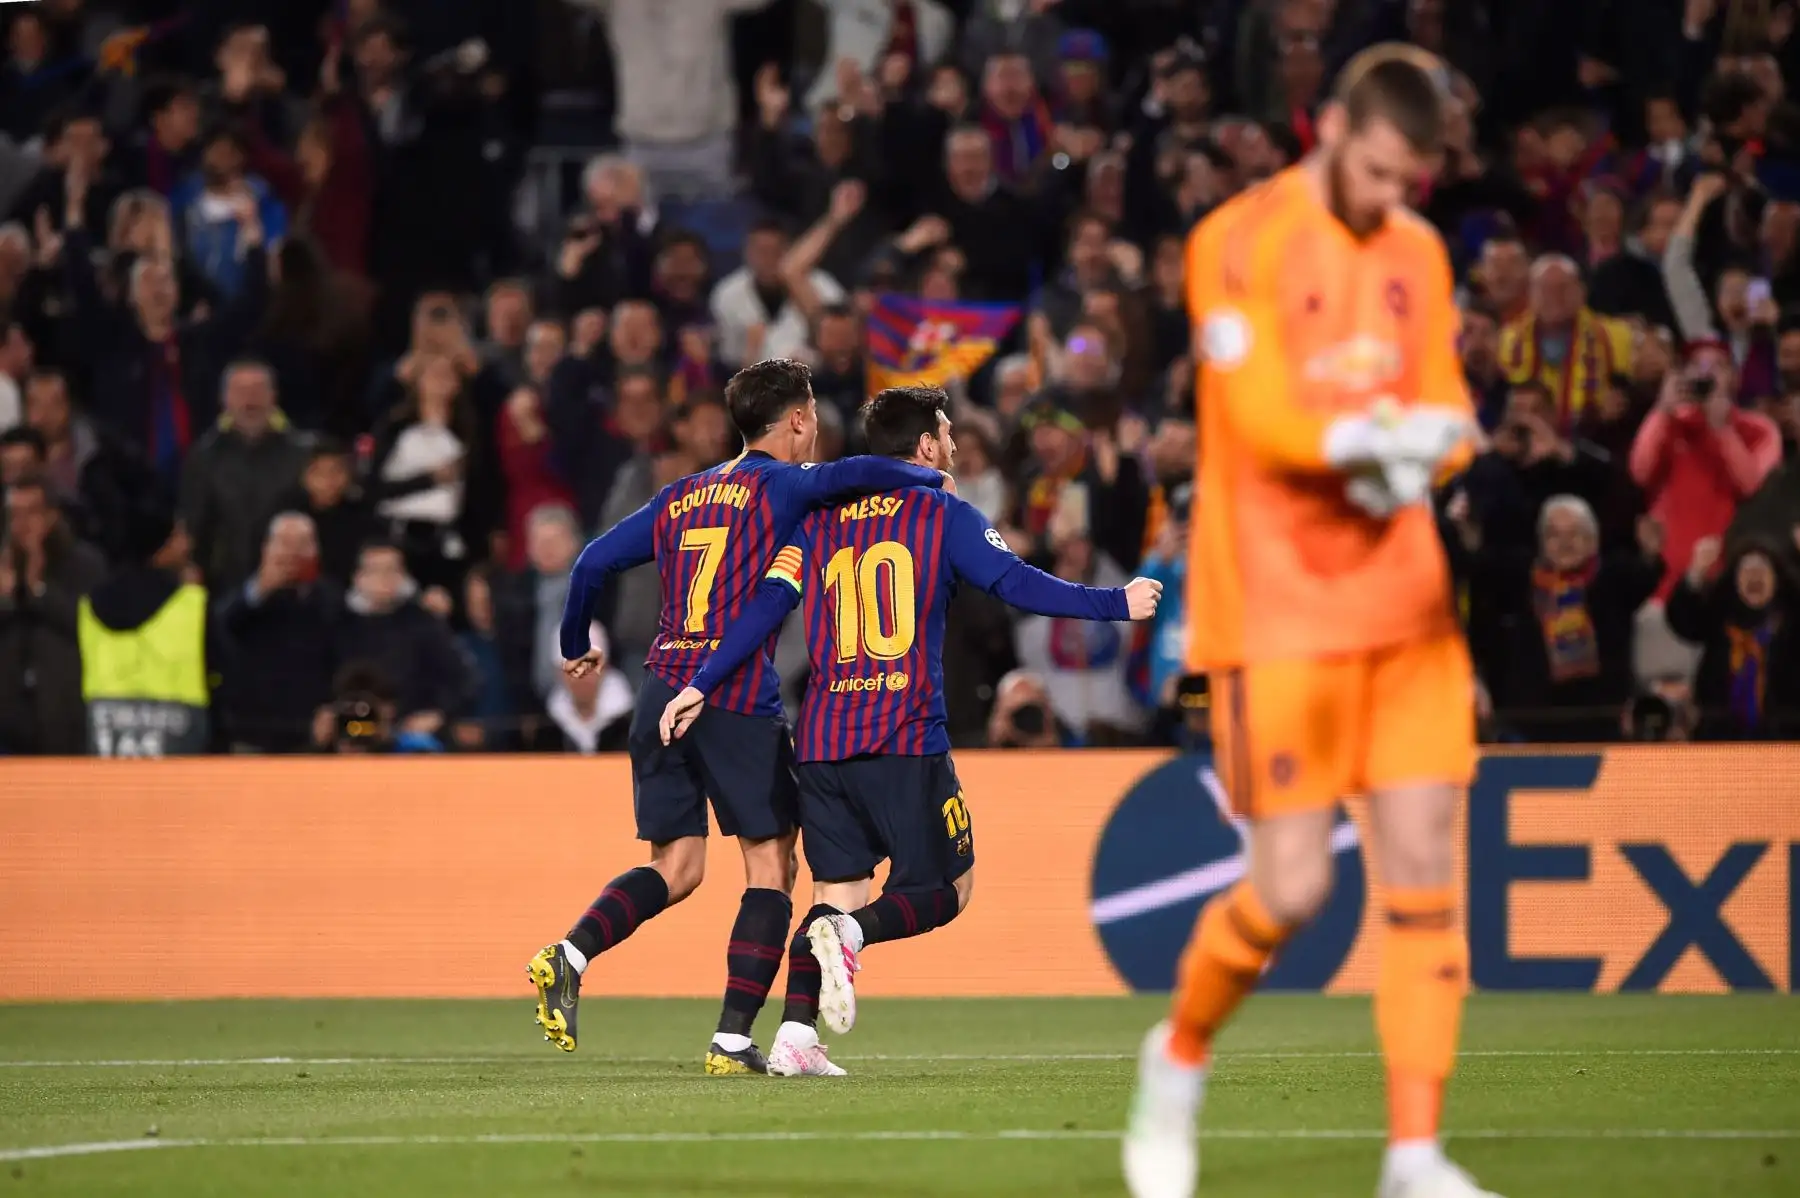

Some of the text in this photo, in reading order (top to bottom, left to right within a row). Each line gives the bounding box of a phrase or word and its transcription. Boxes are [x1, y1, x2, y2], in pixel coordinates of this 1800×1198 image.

[840, 495, 904, 523] MESSI
[679, 527, 729, 632] 7
[822, 541, 915, 663] 10
[830, 672, 884, 692] unicef
[1468, 755, 1800, 991] Ex
[782, 1040, 809, 1072] MESS
